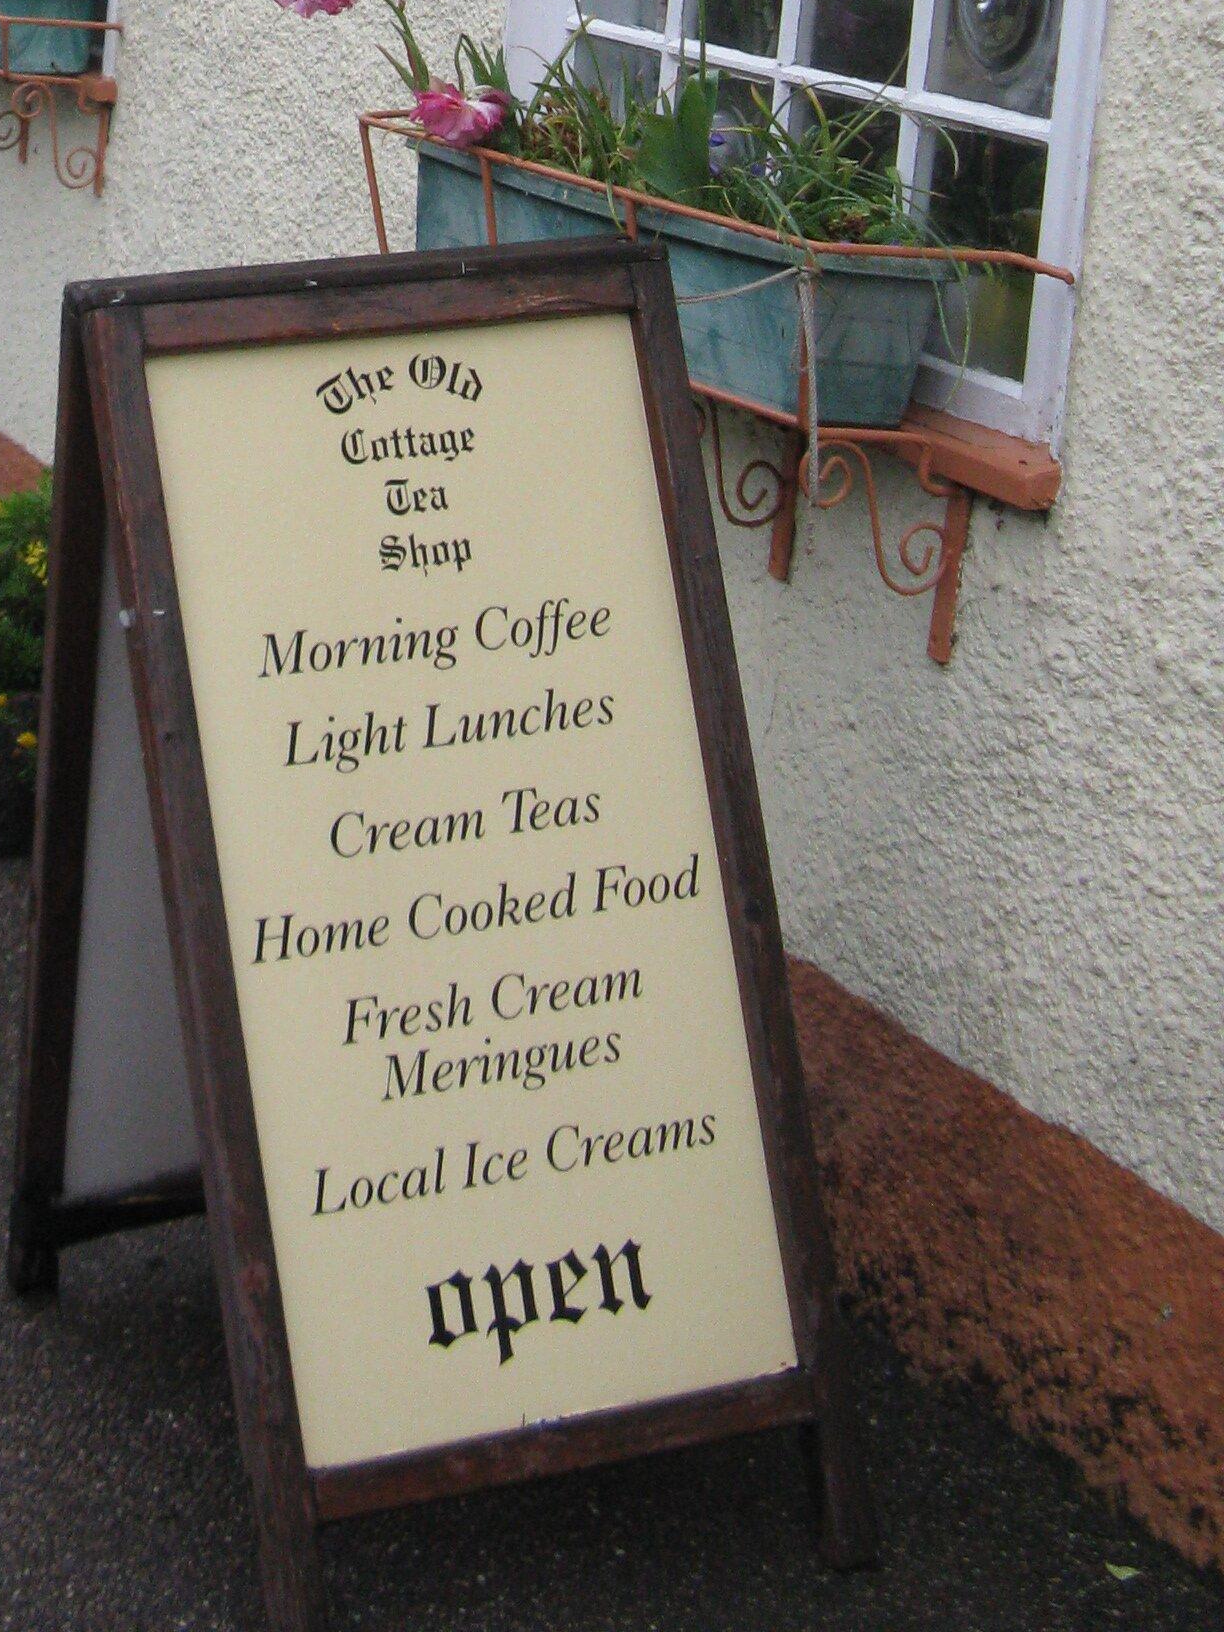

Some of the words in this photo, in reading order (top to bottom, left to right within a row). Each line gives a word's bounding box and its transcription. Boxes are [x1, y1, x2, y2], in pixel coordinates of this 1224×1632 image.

[315, 365, 395, 415] The
[408, 353, 483, 402] Old
[340, 427, 475, 465] Cottage
[384, 478, 449, 516] Tea
[378, 533, 472, 577] Shop
[258, 617, 459, 678] Morning
[474, 597, 611, 659] Coffee
[285, 711, 405, 773] Light
[422, 688, 615, 749] Lunches
[330, 809, 485, 859] Cream
[501, 787, 601, 834] Teas
[253, 914, 390, 964] Home
[408, 871, 577, 940] Cooked
[593, 852, 700, 913] Food
[342, 982, 473, 1045] Fresh
[491, 968, 643, 1020] Cream
[380, 1030, 622, 1101] Meringues
[312, 1147, 446, 1216] Local
[464, 1142, 528, 1189] Ice
[546, 1114, 716, 1173] Creams
[426, 1238, 652, 1366] open
